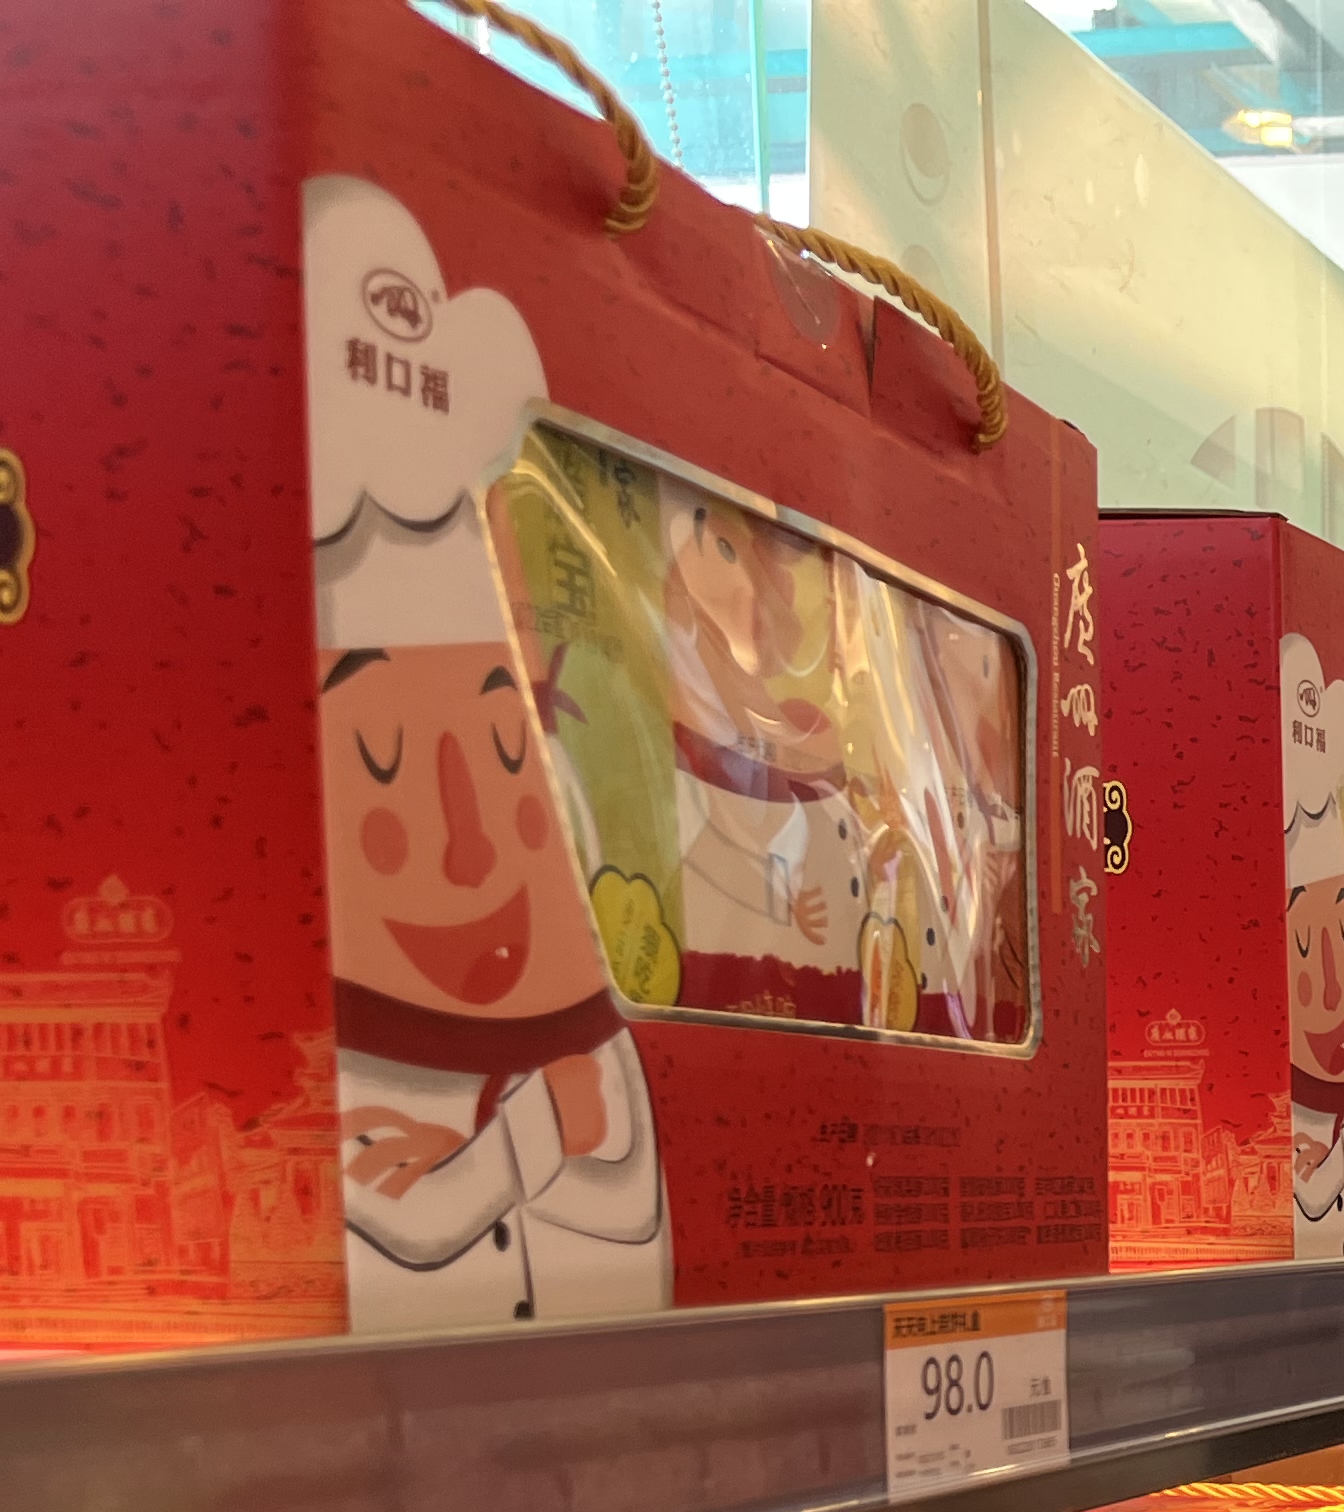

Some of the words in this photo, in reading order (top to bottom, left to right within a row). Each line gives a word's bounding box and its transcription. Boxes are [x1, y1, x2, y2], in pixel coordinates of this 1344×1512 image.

[343, 336, 452, 416] 利口福
[1291, 717, 1328, 756] 利口福
[921, 1349, 995, 1421] 98.0
